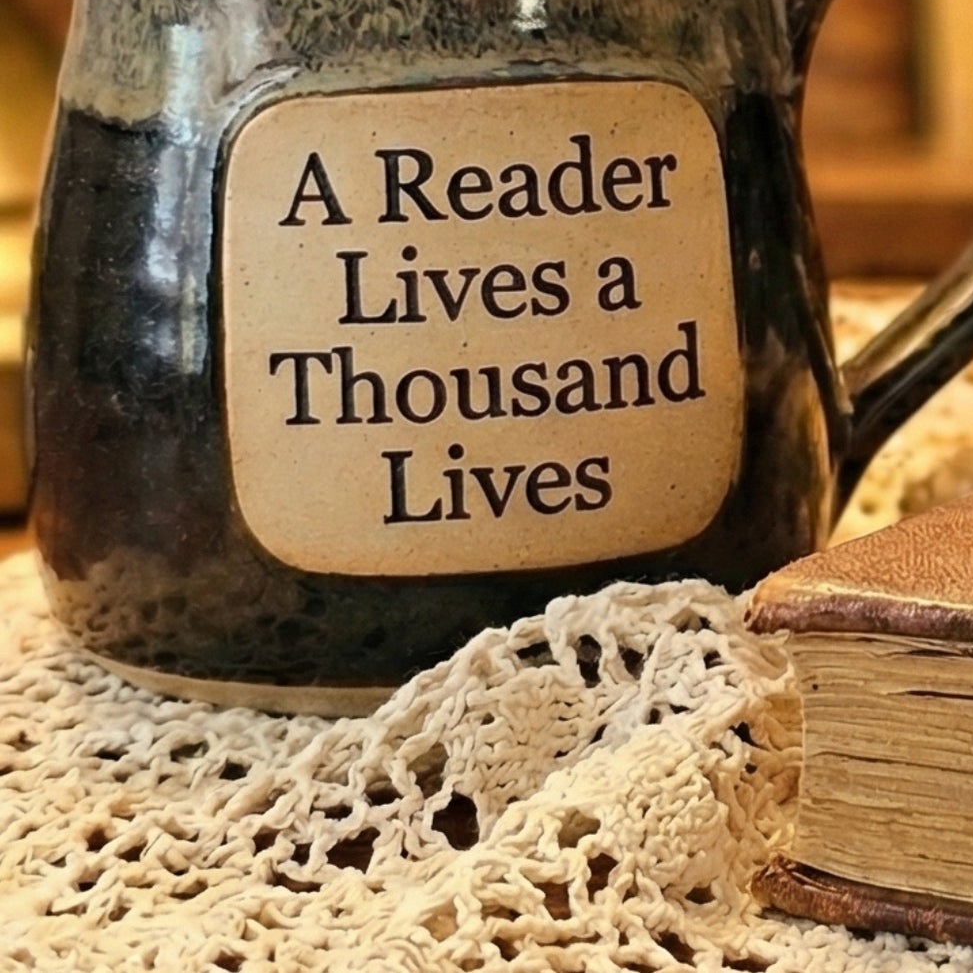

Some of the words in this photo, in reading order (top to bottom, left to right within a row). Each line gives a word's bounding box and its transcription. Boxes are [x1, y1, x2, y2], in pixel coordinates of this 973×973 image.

[279, 151, 352, 225] A
[375, 135, 677, 223] Reader
[336, 245, 570, 324] Lives
[597, 256, 641, 311] a
[269, 321, 705, 424] Thousand
[382, 444, 612, 524] Lives
